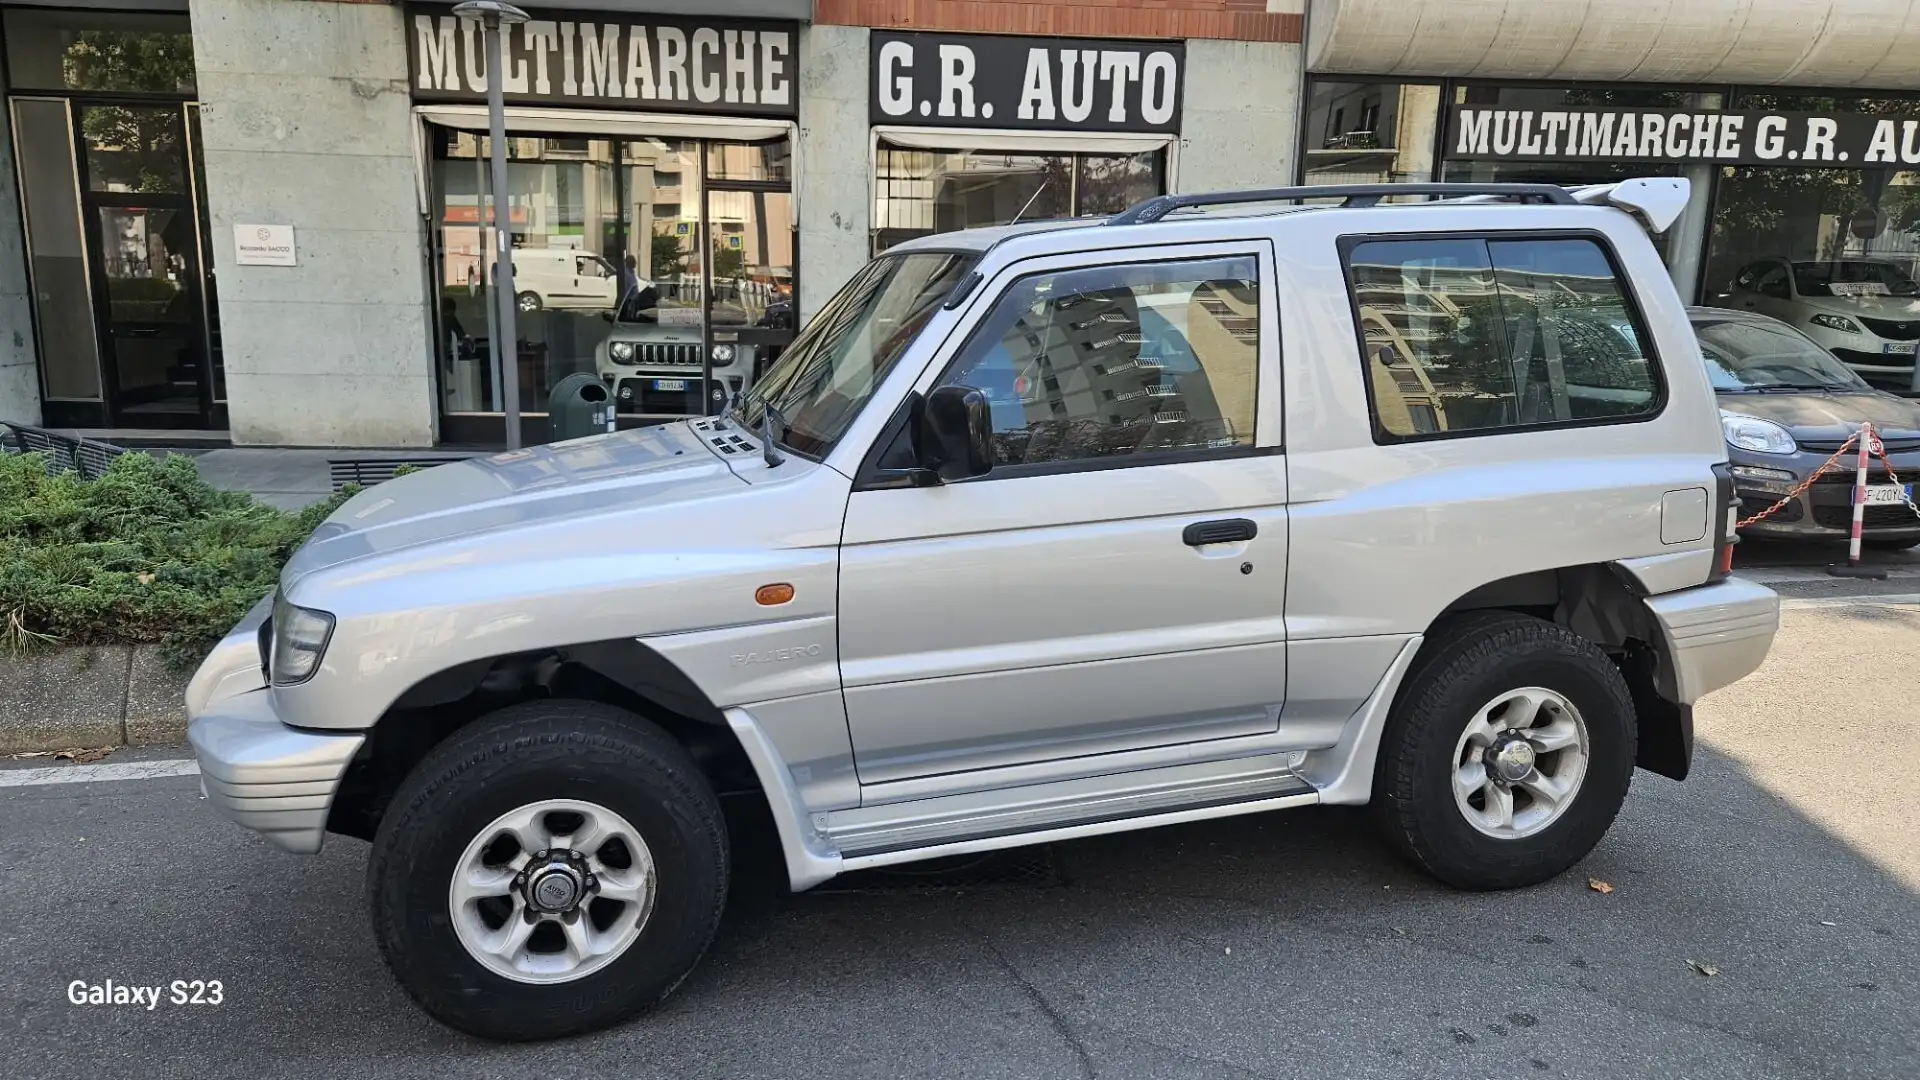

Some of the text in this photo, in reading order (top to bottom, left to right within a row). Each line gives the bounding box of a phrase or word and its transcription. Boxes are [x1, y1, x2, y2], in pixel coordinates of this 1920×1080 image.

[415, 15, 789, 105] MULTIMARCHE
[878, 41, 1177, 125] G.R. AUTO
[1457, 109, 1744, 158] MULTIMARCHE
[1755, 115, 1848, 162] G.R.
[730, 643, 820, 667] PAJERO
